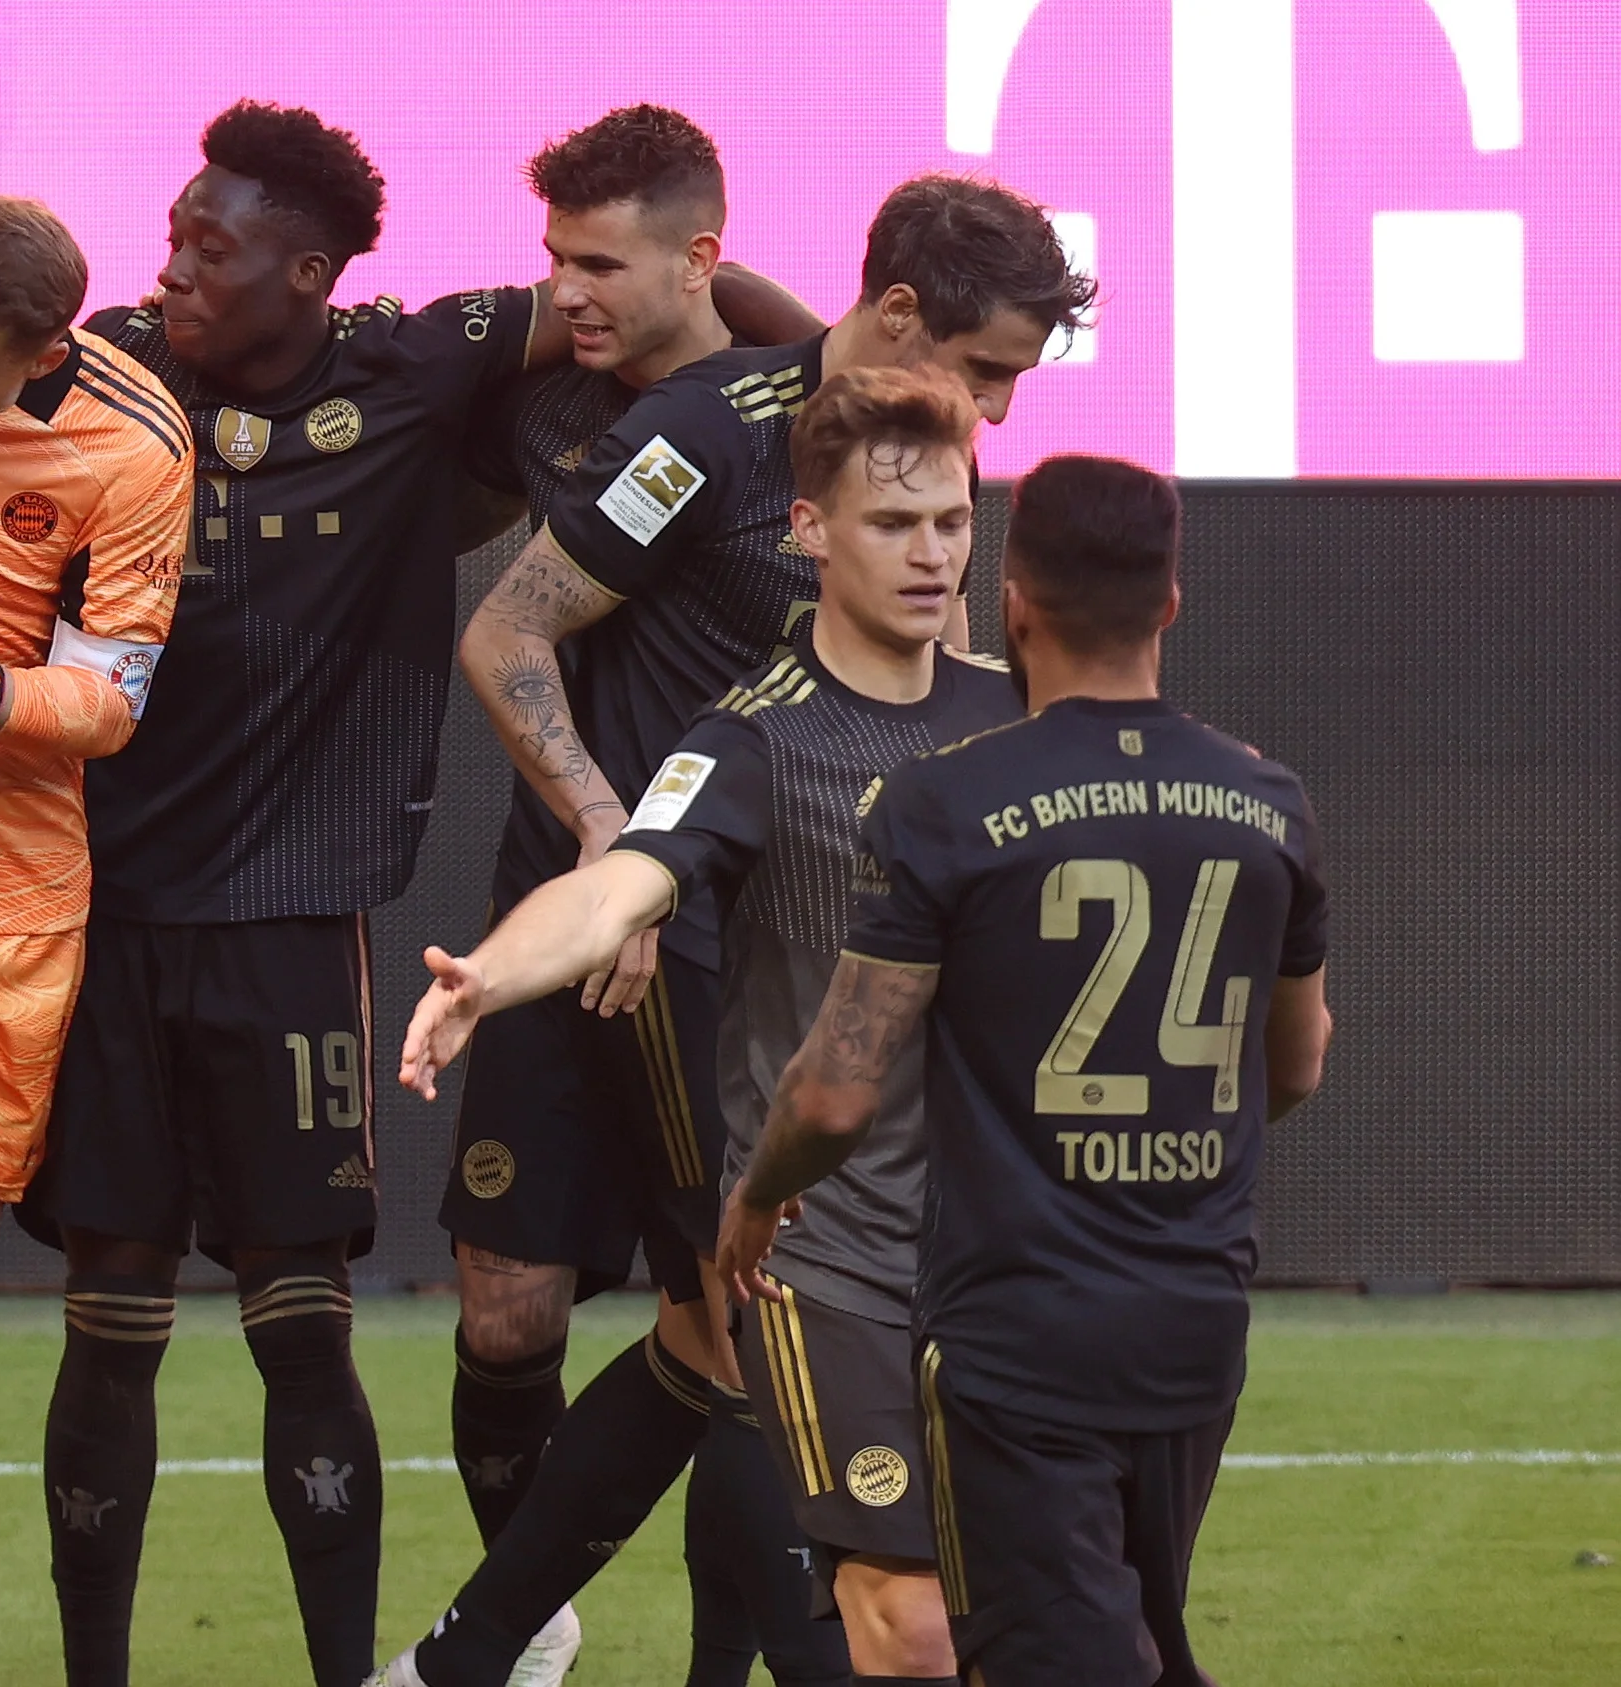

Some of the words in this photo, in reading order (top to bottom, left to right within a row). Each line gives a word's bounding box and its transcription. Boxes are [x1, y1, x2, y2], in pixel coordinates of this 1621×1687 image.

[230, 442, 255, 453] FIFA
[621, 478, 667, 519] BUNDESLIGA
[982, 804, 1029, 848] FC
[1029, 780, 1149, 829] BAYERN
[1156, 780, 1288, 846] MÜNCHEN
[1034, 858, 1252, 1116] 24
[284, 1030, 362, 1130] 19
[1055, 1128, 1224, 1182] TOLISSO
[861, 1450, 901, 1471] BAYERN
